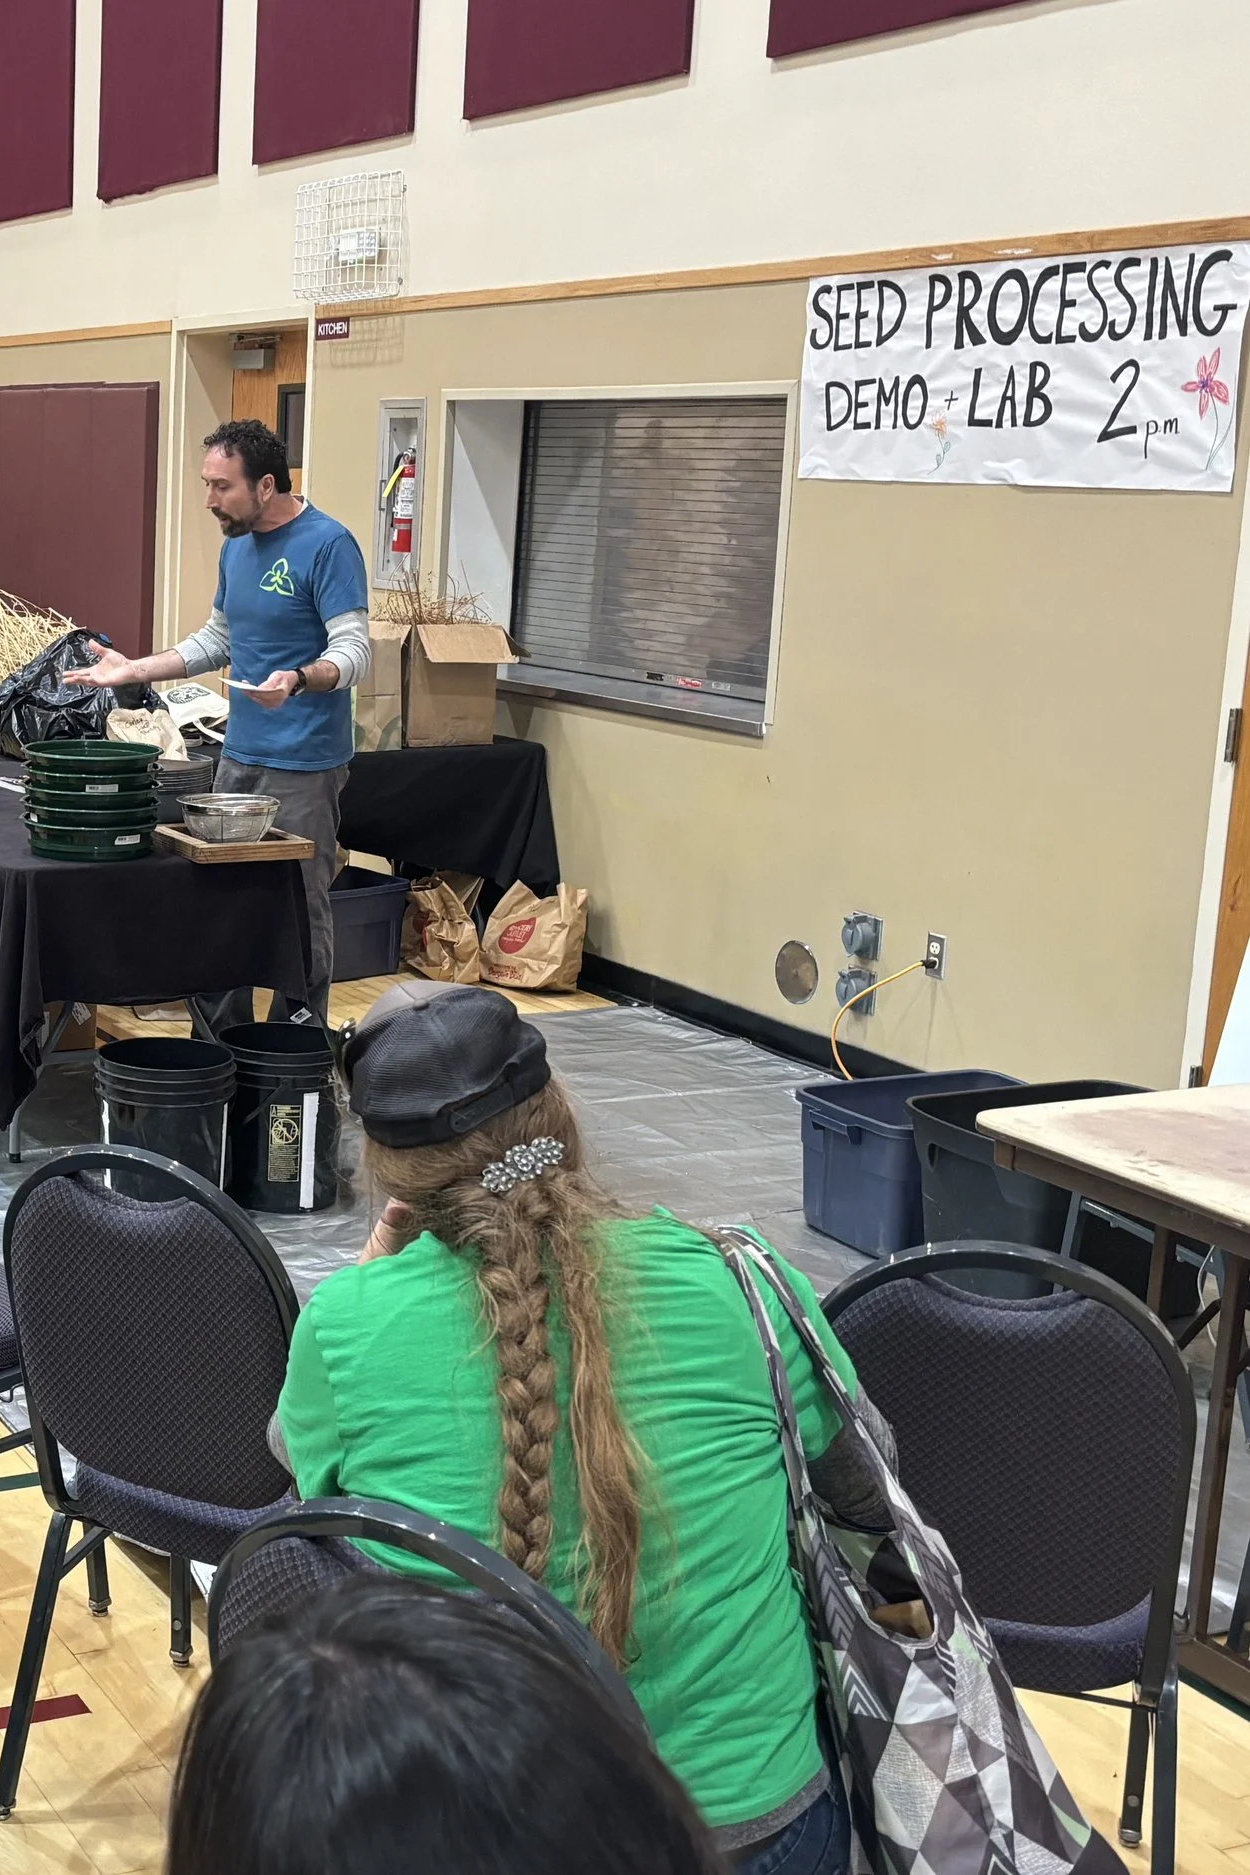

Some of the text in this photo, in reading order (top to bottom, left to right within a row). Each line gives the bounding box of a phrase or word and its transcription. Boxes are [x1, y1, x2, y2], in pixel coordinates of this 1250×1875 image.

[317, 321, 348, 336] KITCHEN
[809, 250, 1238, 351] SEED PROCESSING
[825, 373, 929, 431] DEMO
[944, 390, 959, 412] +
[967, 360, 1053, 429] LAB
[1096, 357, 1140, 443] 2
